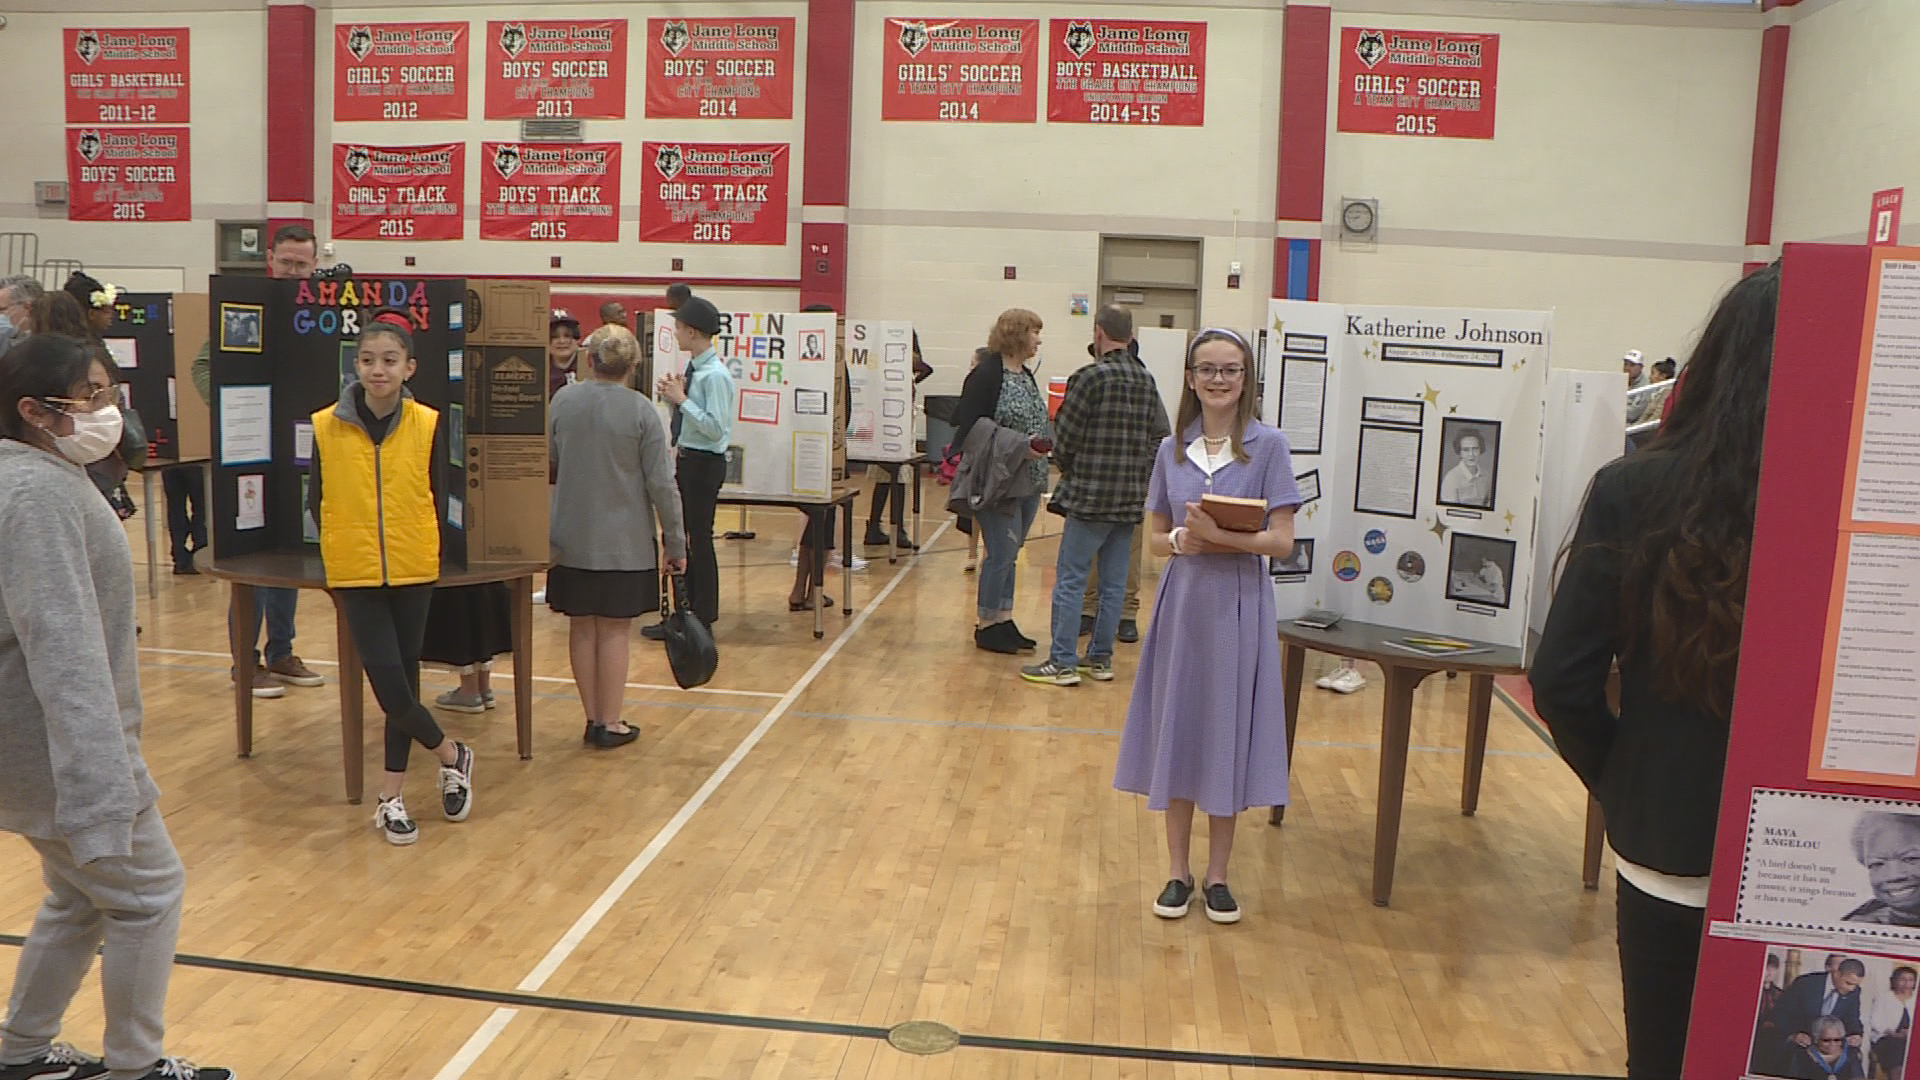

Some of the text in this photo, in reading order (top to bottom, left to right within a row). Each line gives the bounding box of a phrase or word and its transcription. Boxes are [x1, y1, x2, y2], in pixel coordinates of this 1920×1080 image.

[375, 29, 454, 45] Jane Long
[528, 26, 612, 42] Jane Long
[692, 24, 779, 40] Jane Long
[931, 25, 1023, 42] Jane Long
[1097, 25, 1189, 44] Jane Long
[102, 33, 177, 49] Jane Long
[529, 41, 612, 53] Middle School
[692, 40, 779, 51] Middle School
[931, 41, 1022, 53] Middle School
[1098, 41, 1189, 55] Middle School
[1388, 36, 1481, 56] Jane Long
[103, 49, 177, 59] Middle School
[375, 44, 455, 55] Middle School
[1388, 52, 1481, 67] Middle School
[347, 66, 454, 84] GIRLS' SOCCER
[502, 61, 608, 78] BOYS' SOCCER
[664, 60, 775, 76] BOYS' SOCCER
[898, 64, 1022, 82] GIRLS' SOCCER
[1056, 61, 1197, 79] BOYS' BASKETBALL
[110, 73, 184, 87] BASKETBALL
[1143, 80, 1198, 93] CHAMPIONS
[1354, 75, 1481, 98] GIRLS' SOCCER
[541, 86, 594, 99] CHAMPIONS
[704, 86, 760, 97] CHAMPIONS
[909, 83, 937, 95] TEAM
[940, 83, 963, 95] CITY
[967, 83, 1022, 95] CHAMPIONS
[100, 105, 156, 121] 2011-12
[383, 102, 418, 118] 2012
[536, 100, 572, 117] 2013
[700, 99, 737, 116] 2014
[939, 101, 979, 120] 2014
[1090, 104, 1161, 122] 2014-15
[1395, 114, 1437, 134] 2015
[104, 133, 177, 149] Jane Long
[104, 149, 177, 158] Middle School
[373, 151, 450, 163] Jane Long
[523, 148, 606, 164] Jane Long
[685, 149, 773, 166] Jane Long
[81, 166, 176, 182] BOYS' SOCCER
[373, 164, 451, 175] Middle School
[523, 163, 607, 175] Middle School
[685, 165, 773, 176] Middle School
[349, 186, 447, 203] GIRLS' TRACK
[499, 186, 601, 203] BOYS' TRACK
[660, 183, 768, 201] GIRLS' TRACK
[113, 203, 145, 219] 2015
[380, 220, 414, 236] 2015
[530, 222, 567, 239] 2015
[693, 224, 731, 241] 2016
[295, 280, 428, 306] AMANDA
[293, 307, 429, 334] GORN
[719, 313, 784, 335] RTIN
[1346, 315, 1544, 345] Katherine Johnson
[713, 336, 785, 359] THER
[750, 361, 788, 385] JR.
[1763, 827, 1797, 837] MAYA
[1762, 838, 1821, 849] ANGELOU
[1769, 860, 1787, 868] bird
[1787, 861, 1817, 871] doesn't
[1819, 865, 1836, 874] sing
[1758, 871, 1791, 880] because
[1793, 873, 1800, 881] it
[1803, 873, 1817, 882] has
[1763, 894, 1778, 902] has
[1798, 887, 1820, 896] sings
[1822, 887, 1856, 897] because
